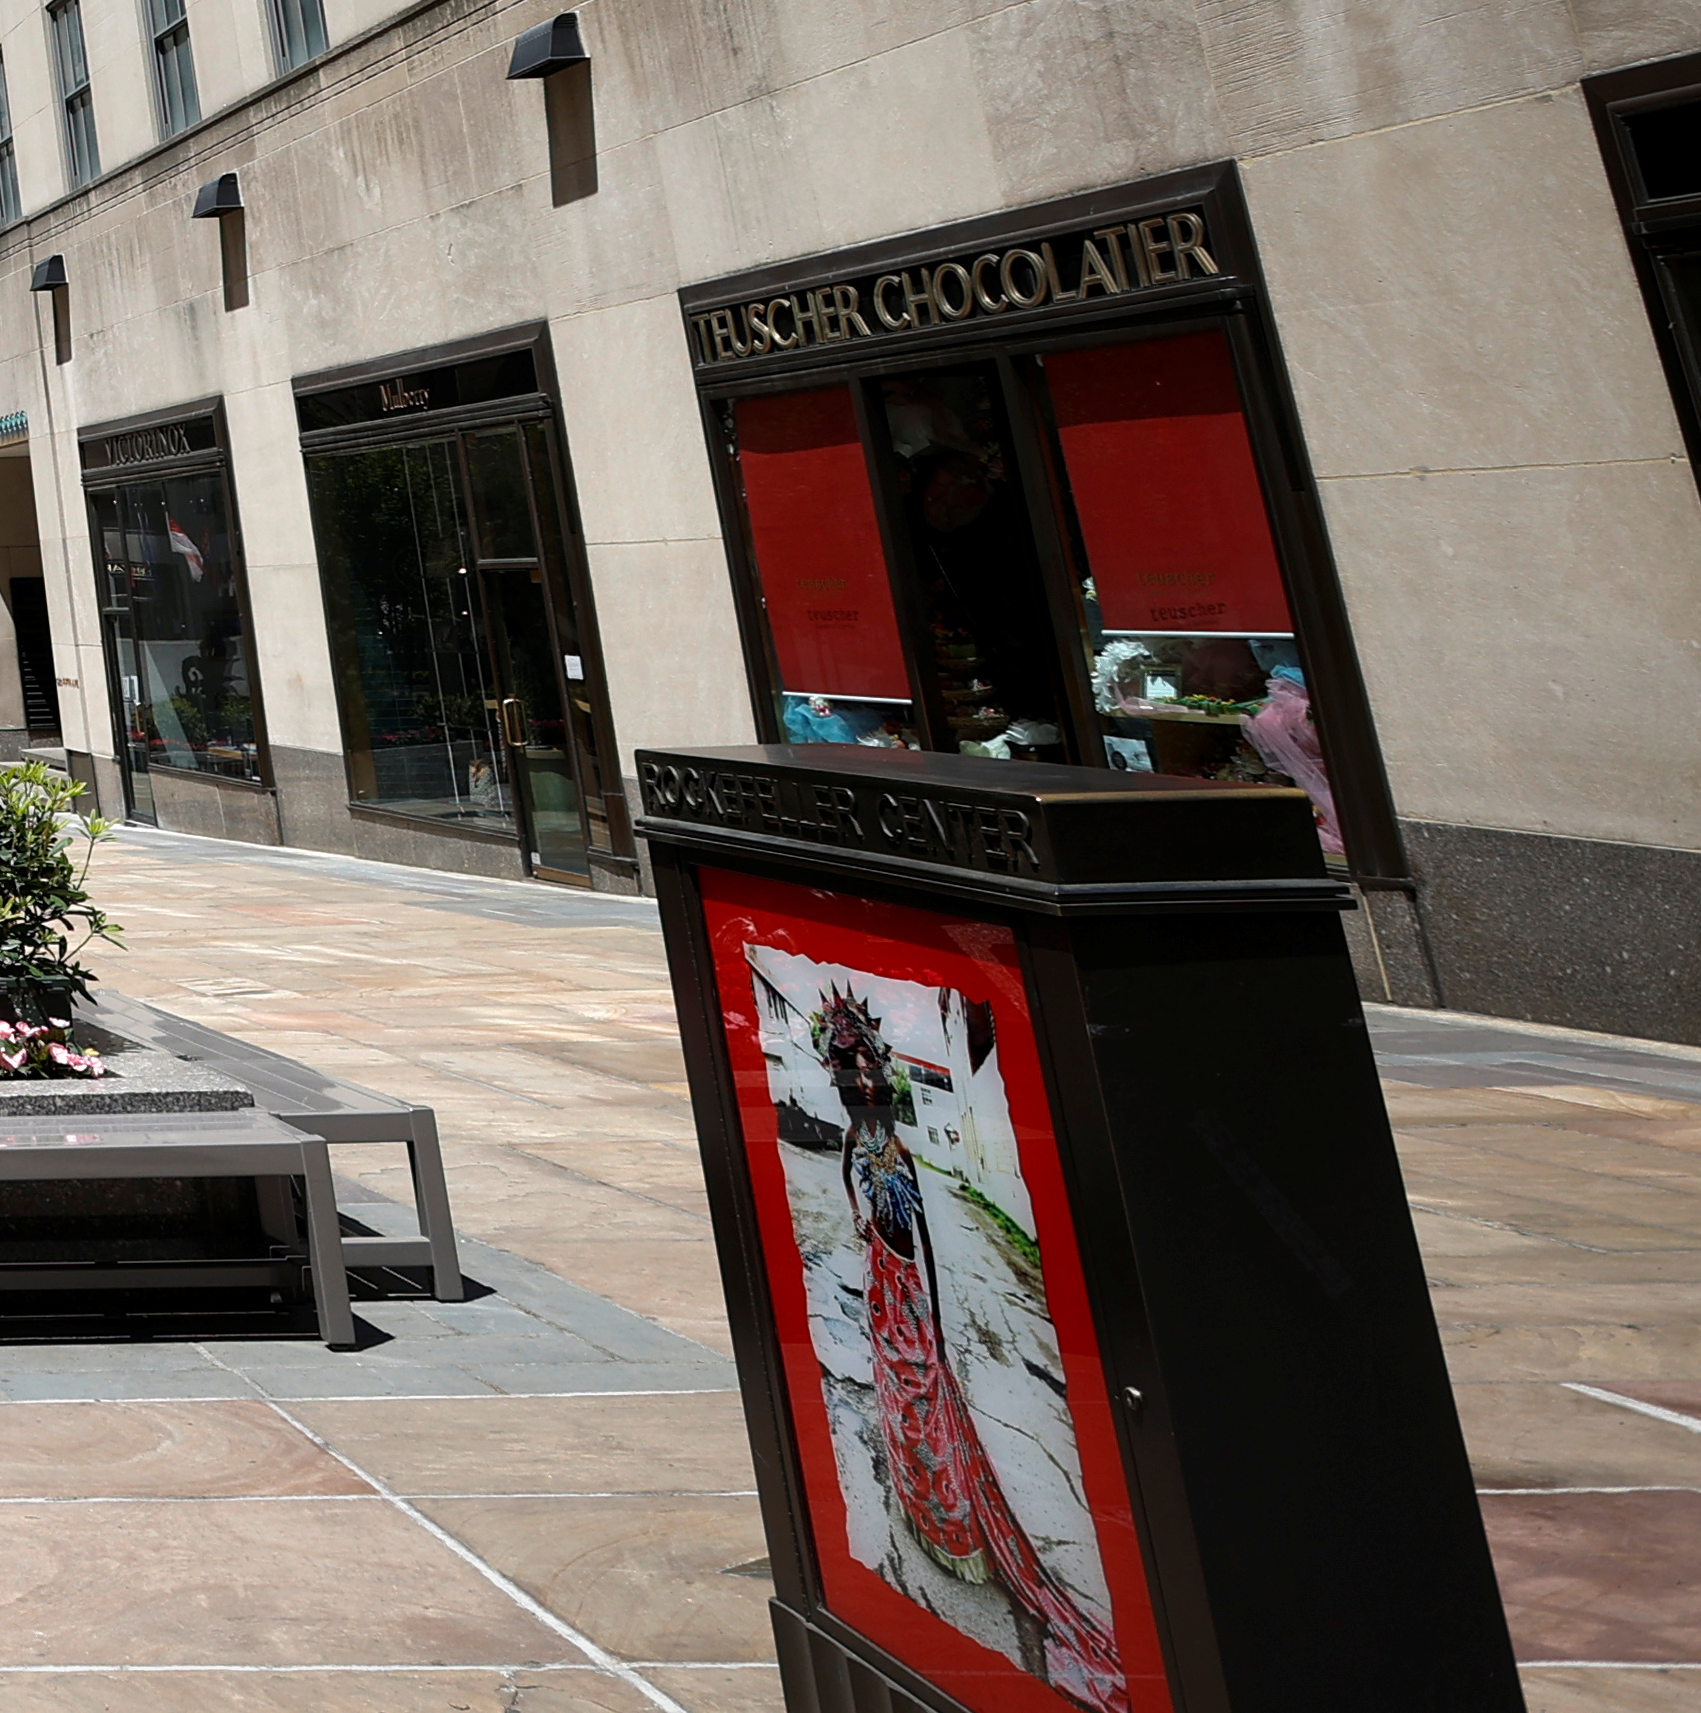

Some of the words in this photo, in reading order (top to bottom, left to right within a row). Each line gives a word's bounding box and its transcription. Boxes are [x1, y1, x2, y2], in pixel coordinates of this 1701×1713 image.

[691, 283, 872, 363] TEUSCHER
[873, 211, 1219, 331] CHOCOLATIER
[379, 377, 431, 412] Mulberry
[104, 422, 192, 465] VICTORINOX
[1149, 601, 1227, 622] teuscher
[643, 761, 866, 841] ROCKEFELLER
[878, 792, 1041, 872] CENTER
